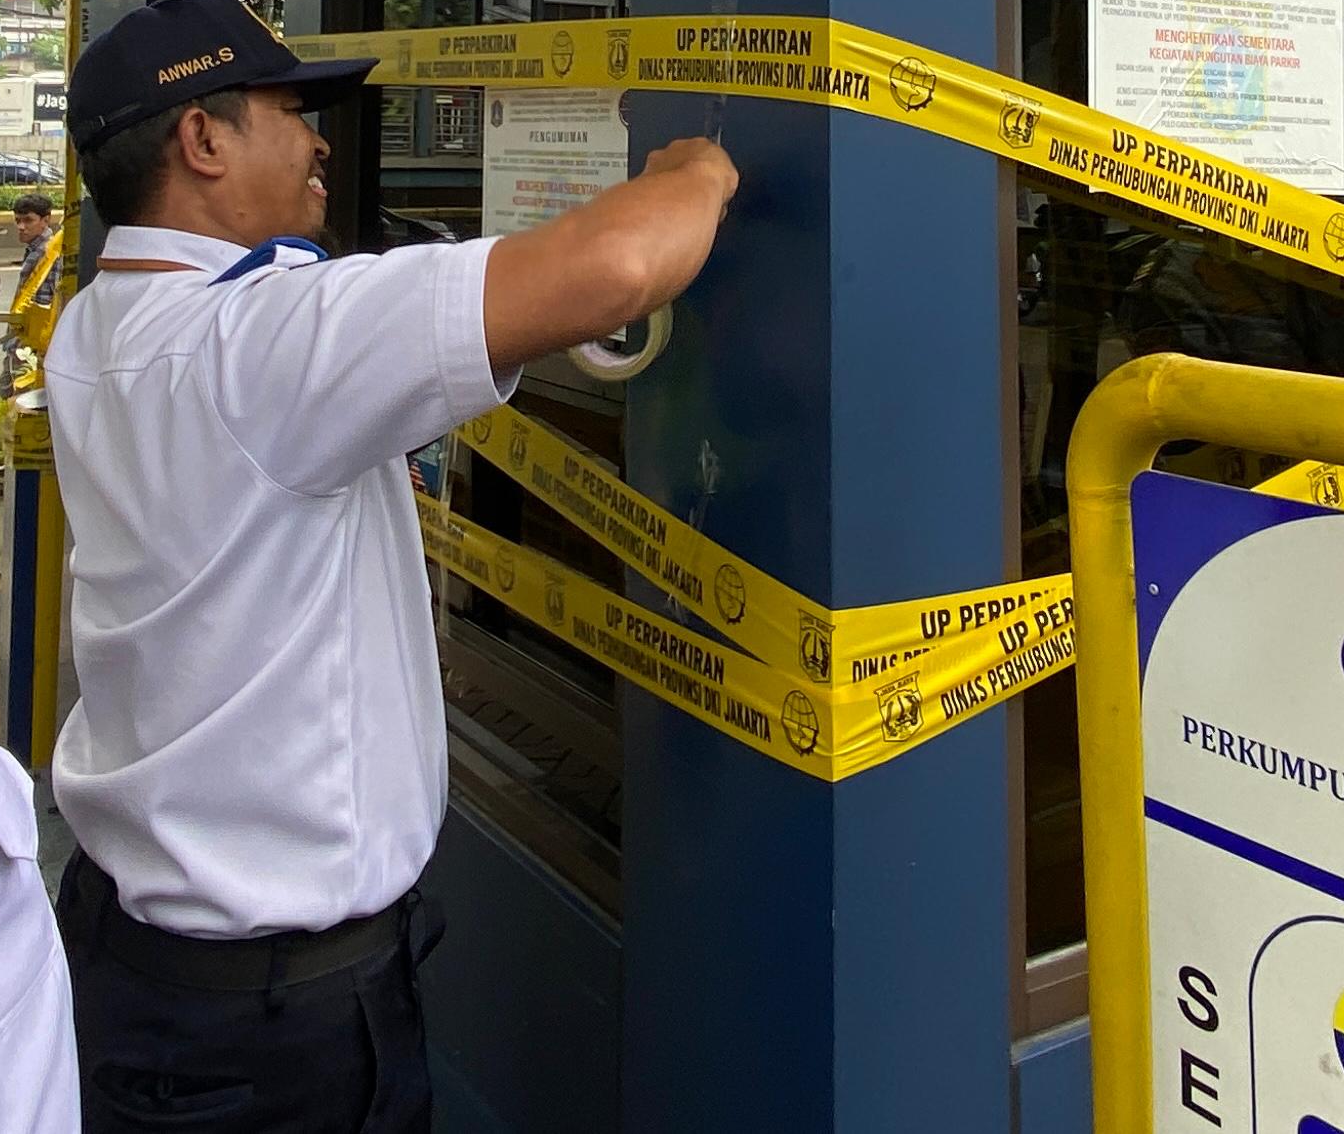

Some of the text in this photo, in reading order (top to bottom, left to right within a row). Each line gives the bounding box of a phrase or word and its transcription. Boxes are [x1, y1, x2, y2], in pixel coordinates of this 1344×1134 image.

[439, 33, 517, 56] UP PERPARKIRAN
[676, 27, 812, 56] UP PERPARKIRAN
[1149, 46, 1301, 69] KEGIATAN PUNGUTAN BIAYA PARKIR
[1155, 28, 1296, 52] MENGHENTIKAN SEMENTARA
[158, 47, 235, 85] ANWAR.S
[638, 57, 870, 102] DINAS PERHUBUNGAN PROVINSI DKI JAKARTA
[529, 130, 588, 143] PENGUMUMAN
[1112, 128, 1138, 154] UP
[1143, 140, 1269, 208] PERPARKIRAN
[1048, 138, 1089, 173] DINAS
[1090, 153, 1181, 207] PERHUBUNGAN
[1183, 186, 1236, 226] PROVINSI
[1239, 206, 1258, 235] DKI
[1260, 217, 1310, 253] JAKARTA
[563, 455, 667, 546] UP PERPARKIRAN
[607, 512, 645, 563] PROVINSI
[645, 541, 661, 572] DKI
[661, 552, 703, 607] JAKARTA
[605, 602, 725, 686] UP PERPARKIRAN
[921, 609, 951, 640] UP
[998, 620, 1029, 655] UP
[659, 662, 703, 707] PROVINSI
[703, 690, 722, 719] DKI
[723, 697, 771, 743] JAKARTA
[940, 675, 988, 720] DINAS
